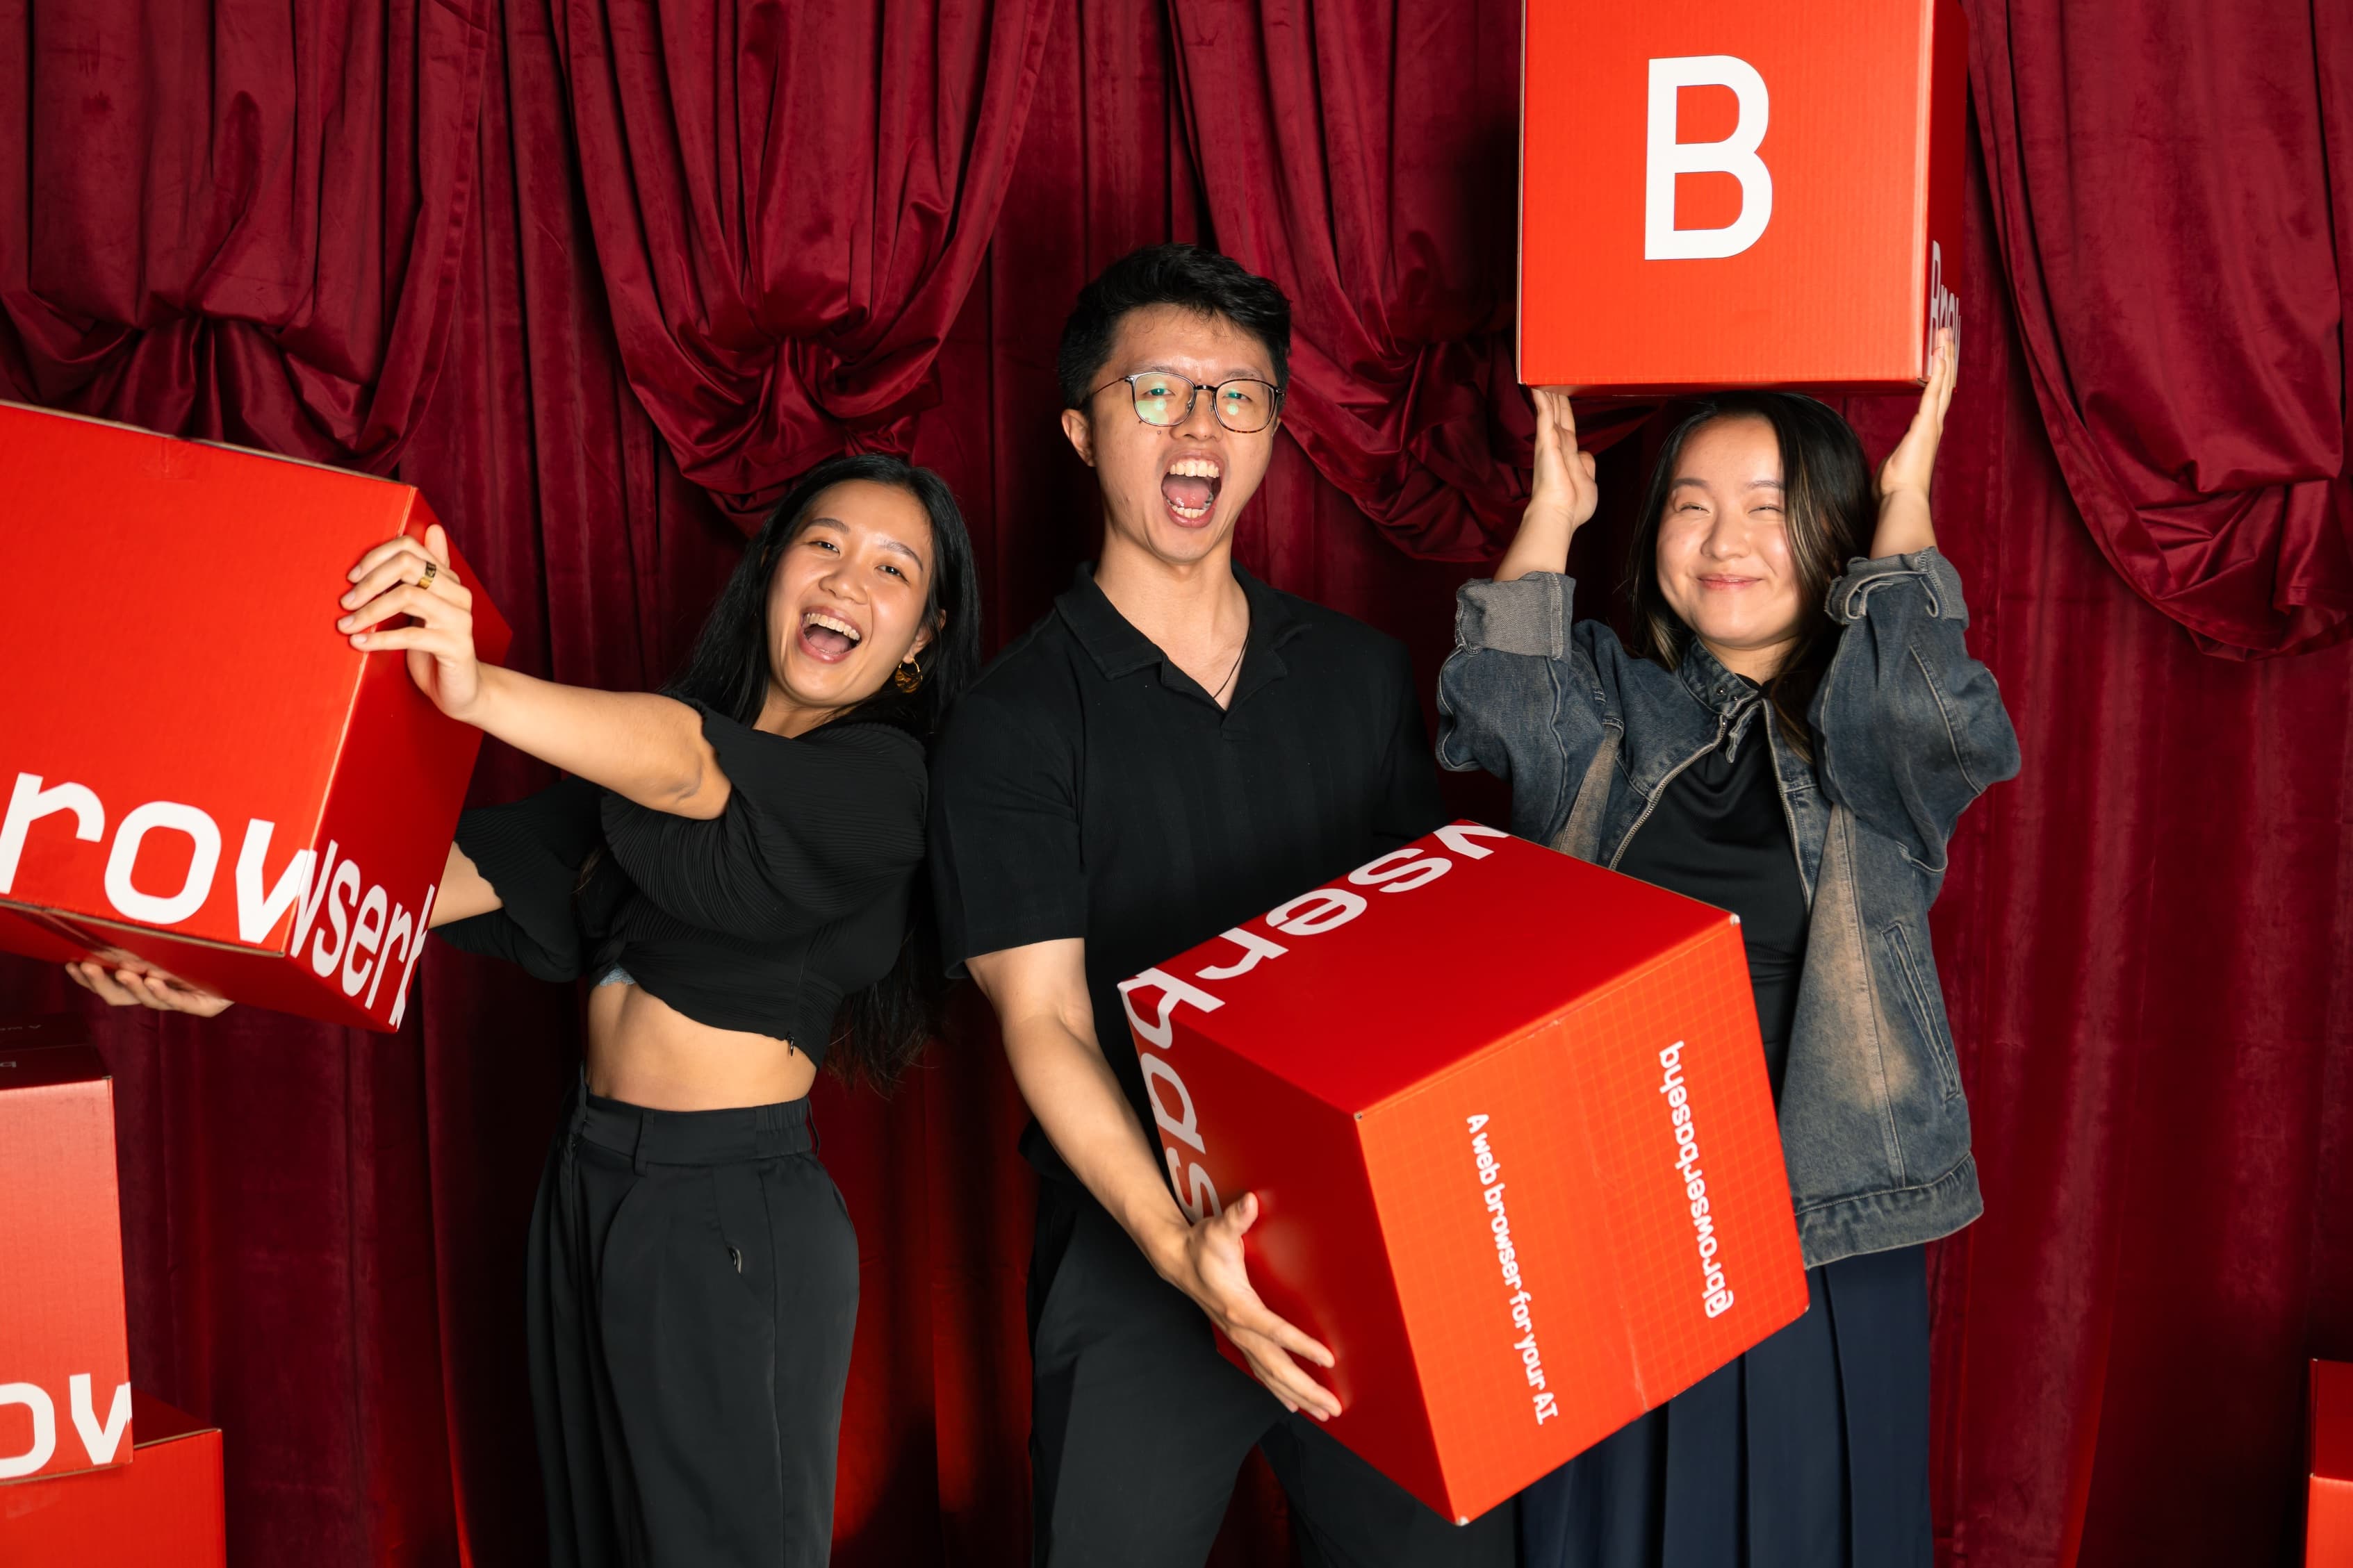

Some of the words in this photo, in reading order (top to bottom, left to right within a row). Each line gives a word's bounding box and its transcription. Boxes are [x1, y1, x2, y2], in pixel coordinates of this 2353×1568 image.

[1645, 55, 1773, 260] B
[1466, 1114, 1489, 1134] A
[1471, 1132, 1501, 1185] web
[1659, 1040, 1734, 1319] @browserbasehq
[1483, 1182, 1523, 1290] browser
[1509, 1290, 1532, 1332] for
[1514, 1332, 1546, 1390] your
[1532, 1392, 1559, 1426] AI
